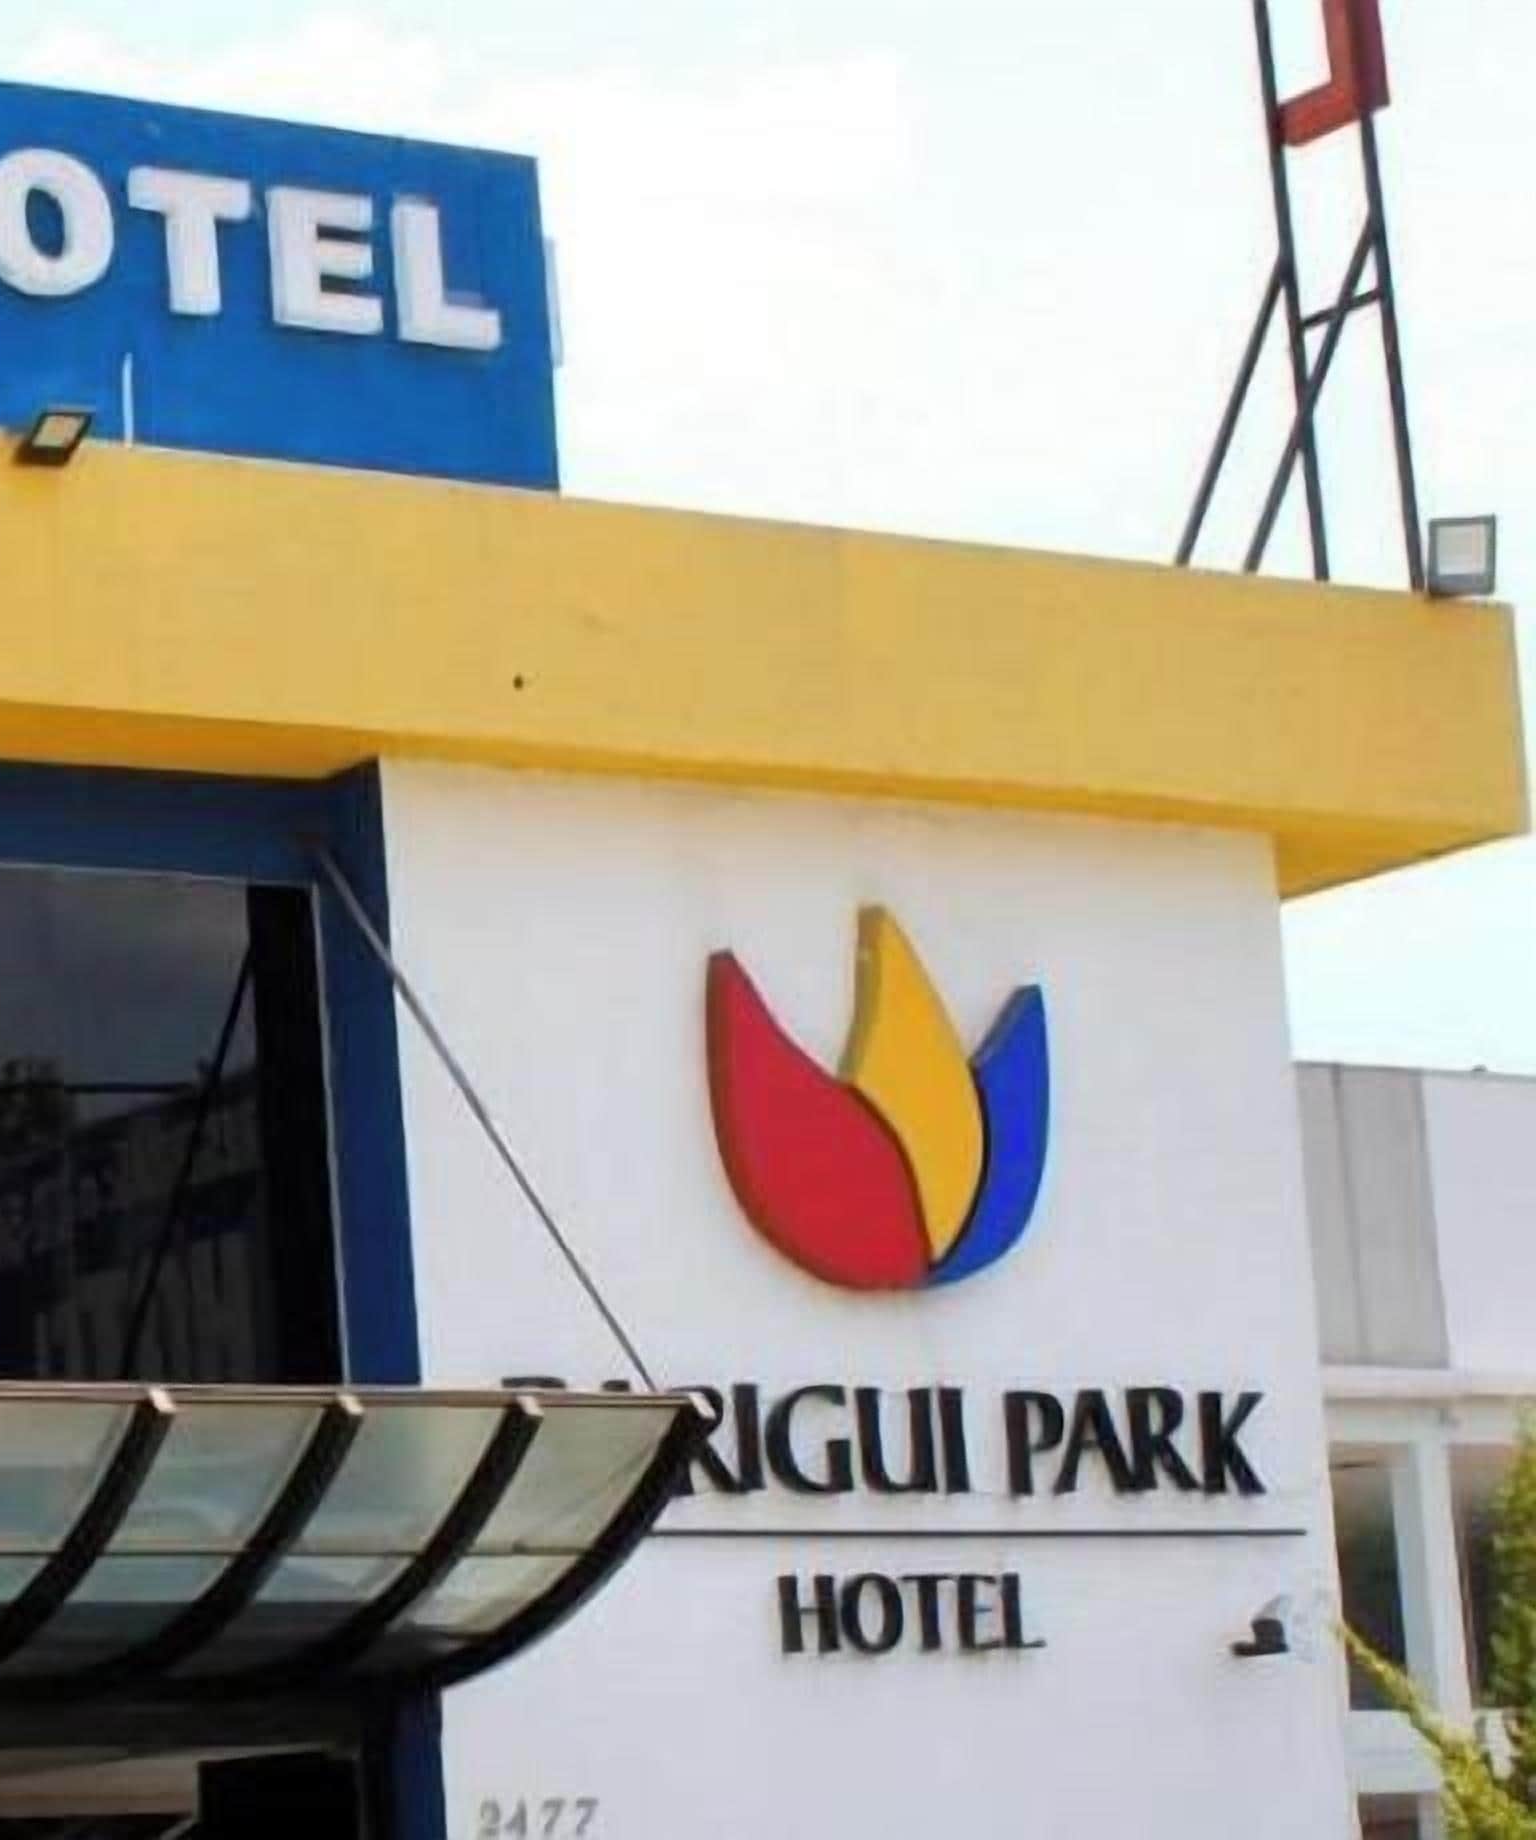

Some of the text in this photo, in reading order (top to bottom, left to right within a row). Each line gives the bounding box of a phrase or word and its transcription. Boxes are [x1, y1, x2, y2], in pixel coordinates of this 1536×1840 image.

[501, 1376, 1264, 1496] RIGUI PARK
[779, 1572, 1044, 1654] HOTEL
[479, 1797, 599, 1838] 2477
